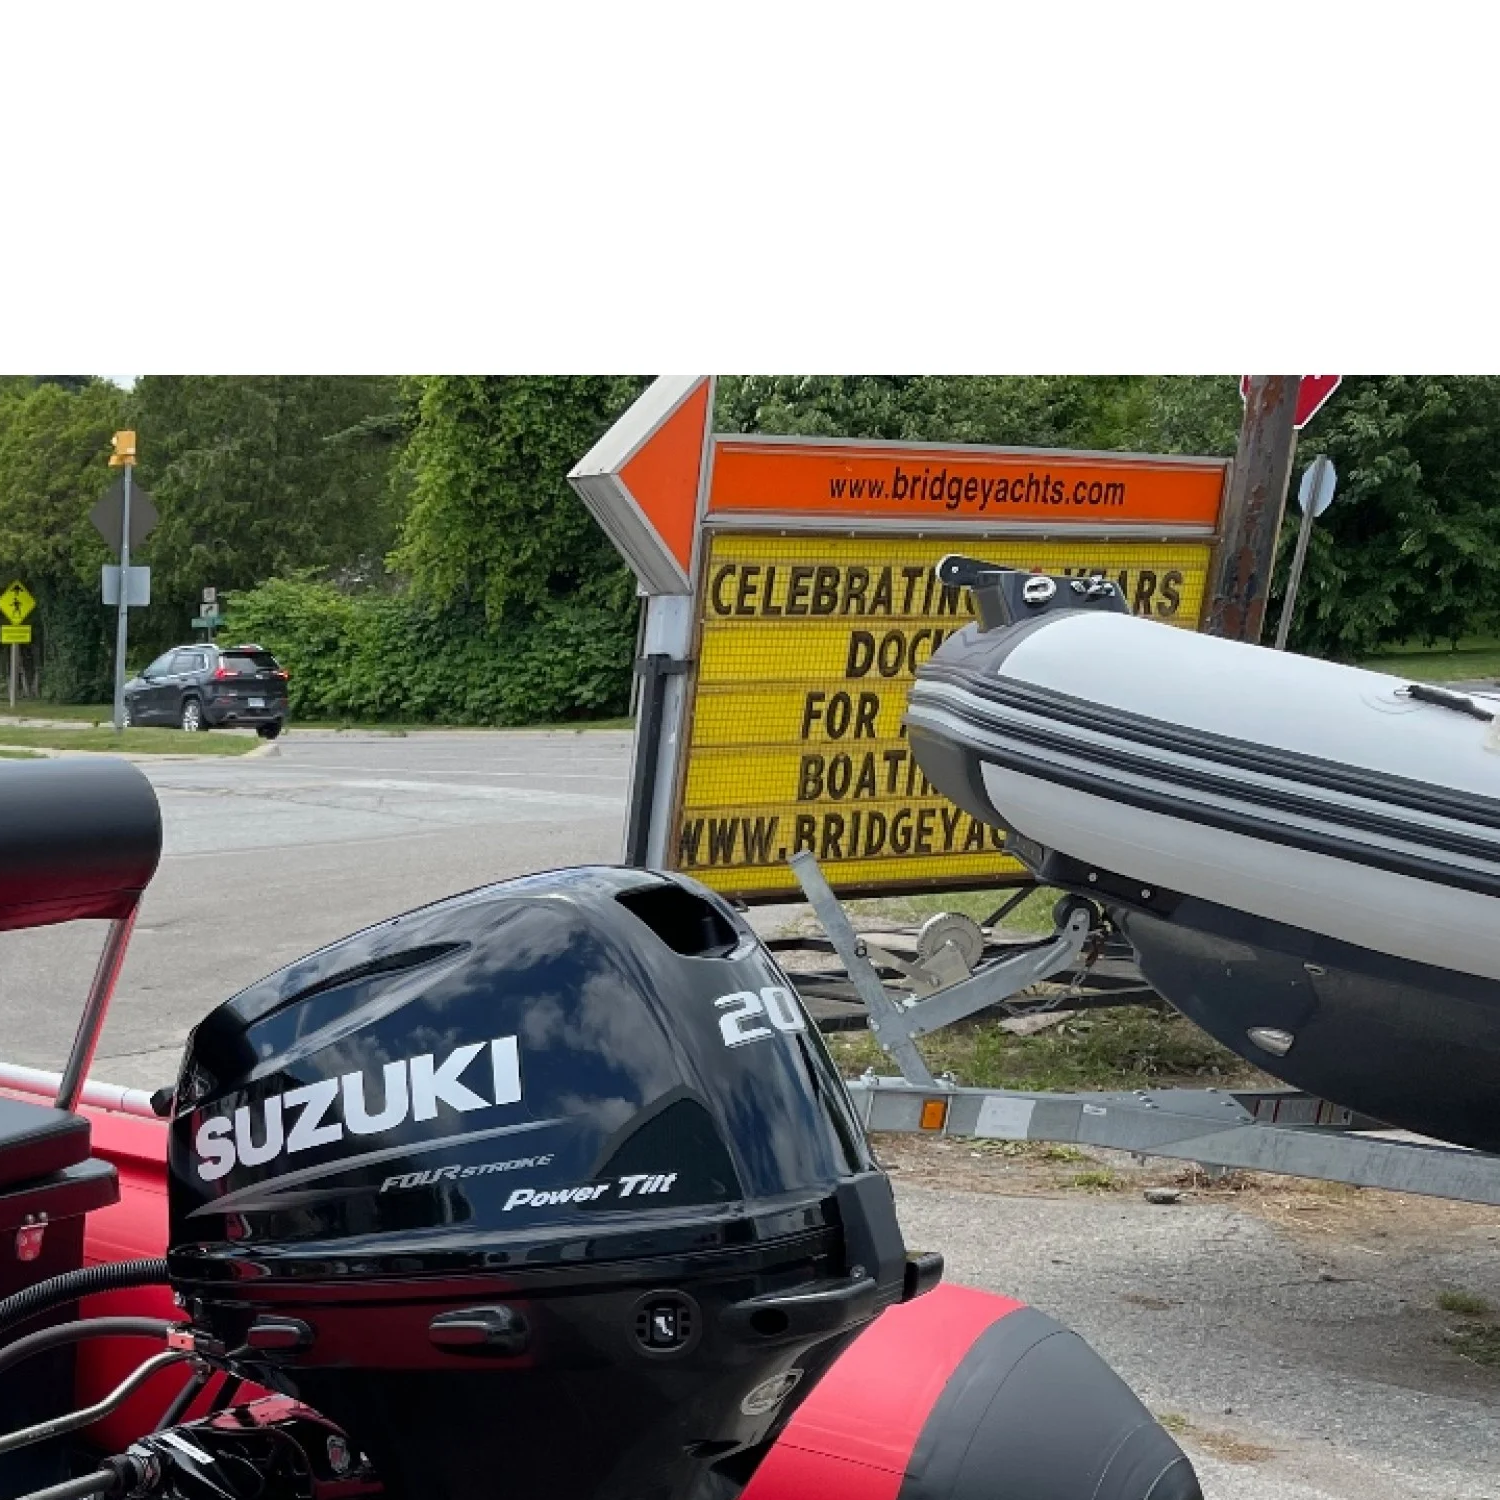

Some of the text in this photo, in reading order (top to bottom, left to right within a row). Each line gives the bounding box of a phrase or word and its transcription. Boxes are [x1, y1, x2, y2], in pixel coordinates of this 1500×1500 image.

[828, 466, 1126, 511] www.bridgeyachts.com
[711, 563, 976, 617] CELEBRATIN
[801, 691, 881, 740] FOR
[713, 986, 806, 1048] 20
[195, 1034, 522, 1181] SUZUKI
[502, 1172, 679, 1212] Power Tilt
